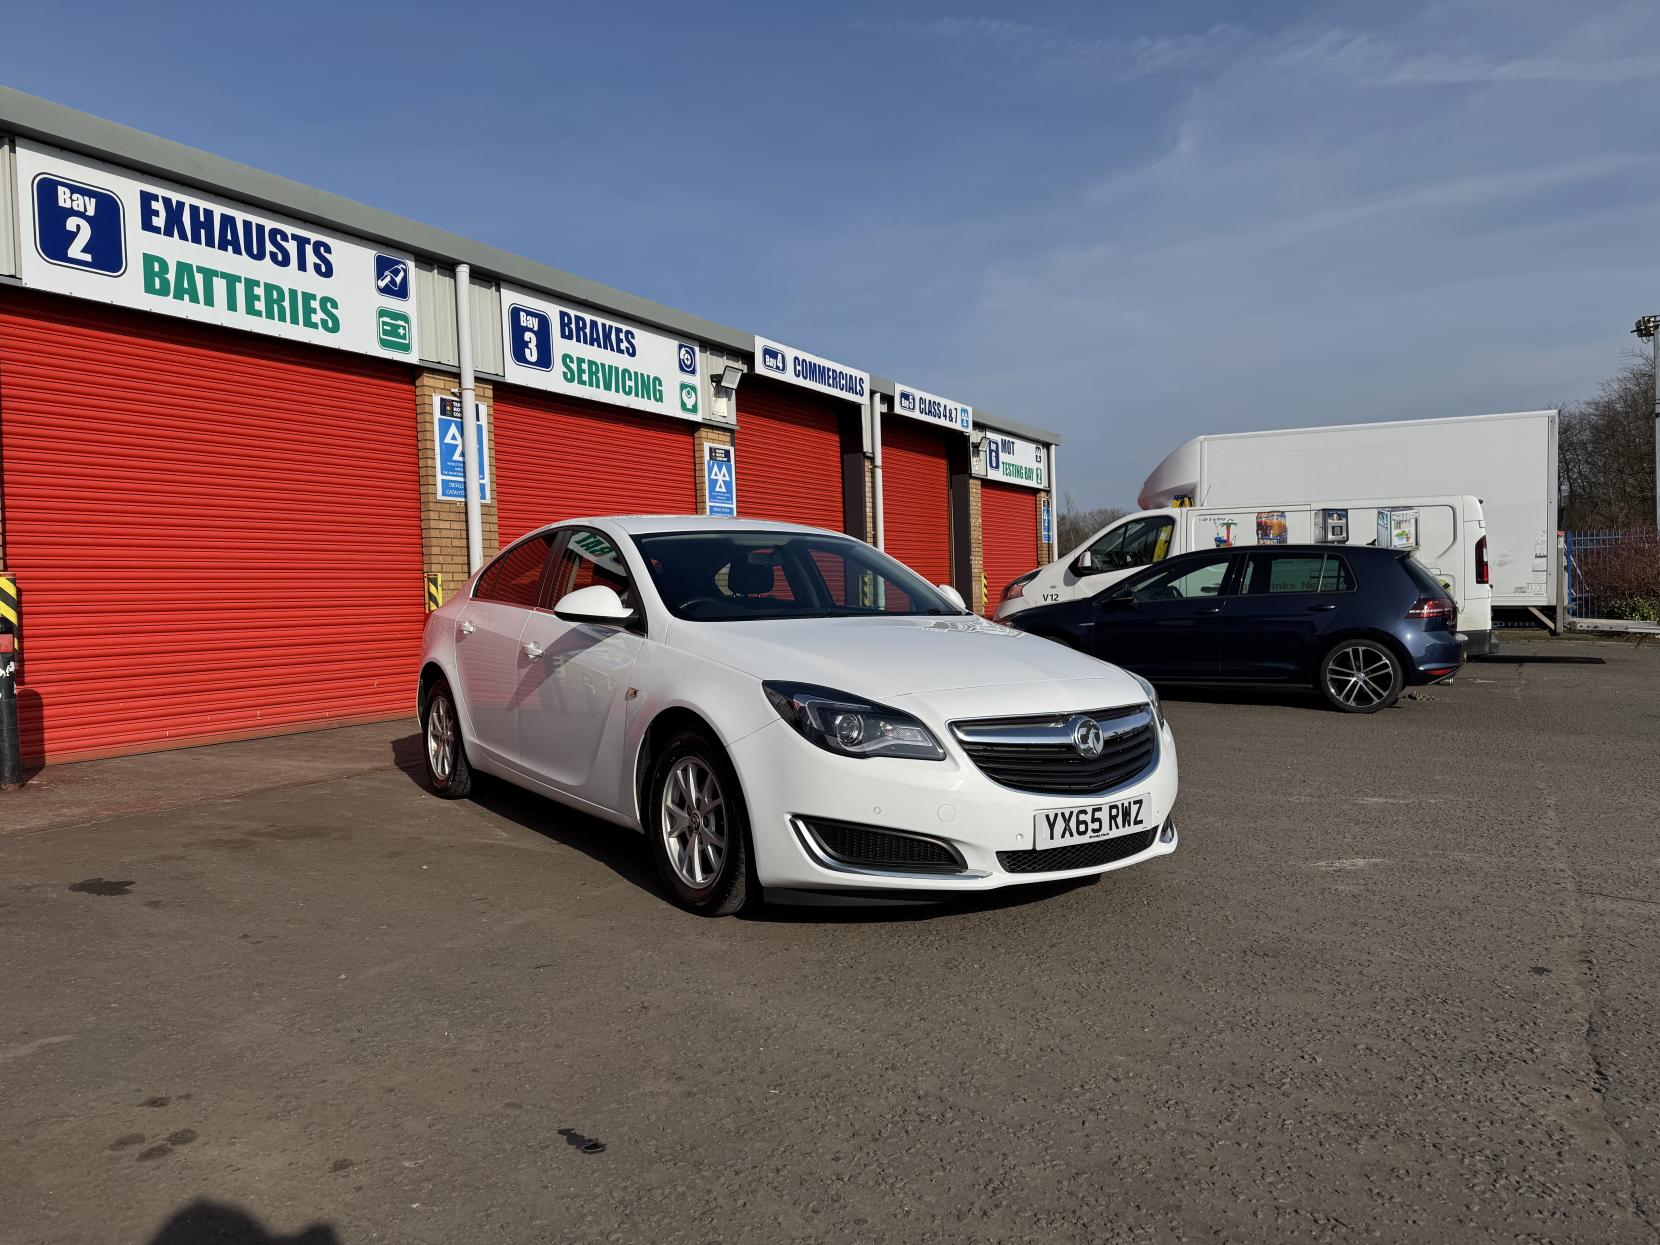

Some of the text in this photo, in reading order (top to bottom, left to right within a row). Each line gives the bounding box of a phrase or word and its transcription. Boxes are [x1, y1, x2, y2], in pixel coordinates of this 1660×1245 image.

[57, 185, 96, 217] Bay
[65, 216, 92, 263] 2
[139, 189, 334, 279] EXHAUSTS
[142, 252, 341, 334] BATTERIES
[519, 311, 539, 331] Bay
[559, 310, 637, 358] BRAKES
[523, 331, 538, 363] 3
[765, 353, 783, 370] Bay 4
[561, 353, 664, 403] SERVICING
[793, 356, 865, 398] COMMERCIALS
[909, 395, 914, 409] 5
[919, 397, 958, 424] CLASS 4 & 7
[1001, 438, 1015, 456] MOT
[1001, 461, 1034, 482] TESTING BAY
[1045, 798, 1144, 841] YX65 RWZ
